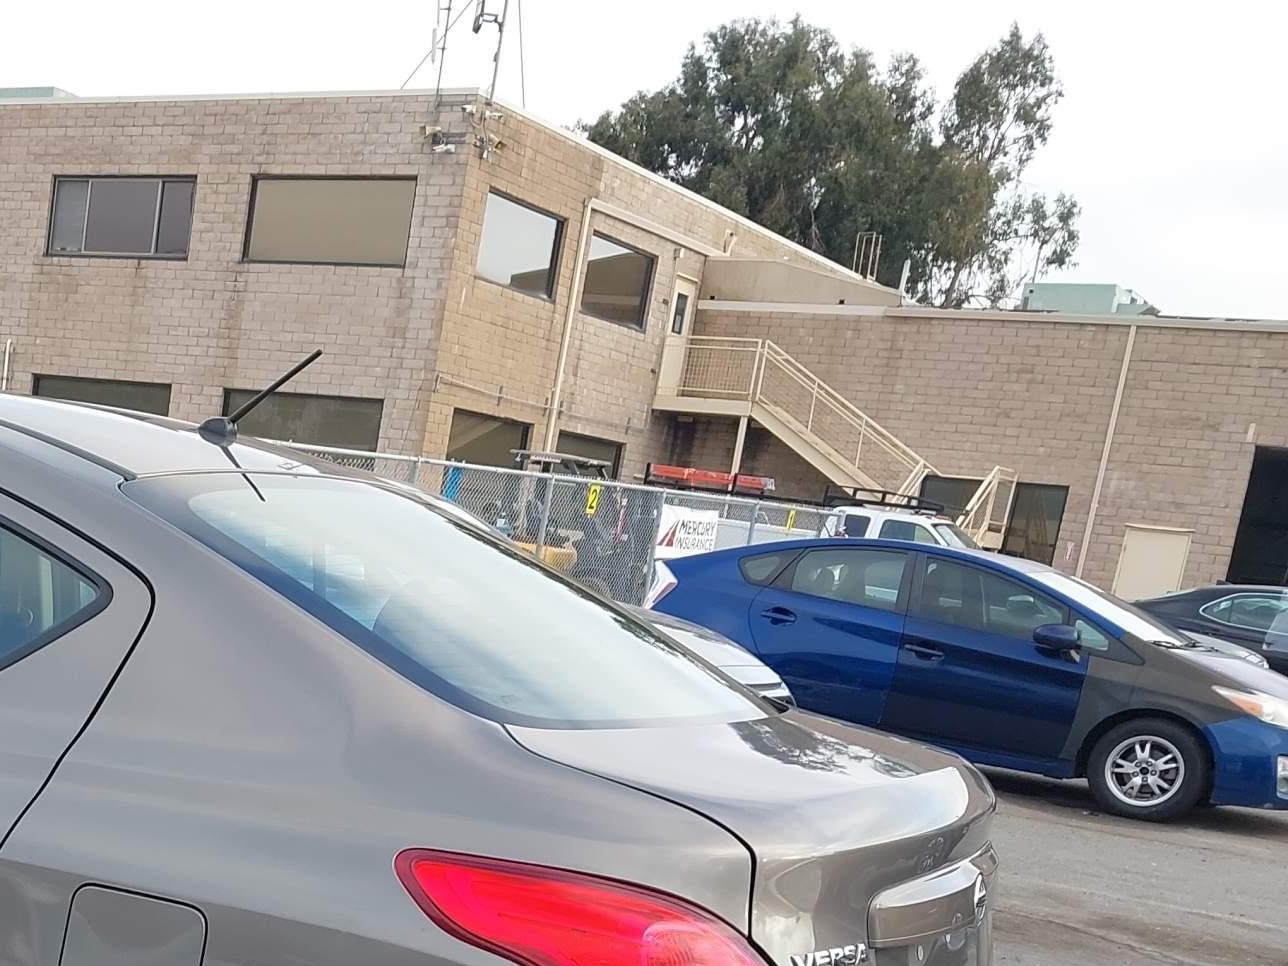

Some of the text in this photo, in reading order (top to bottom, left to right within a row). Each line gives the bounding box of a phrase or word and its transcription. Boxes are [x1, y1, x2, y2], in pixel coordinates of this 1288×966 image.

[588, 488, 598, 509] 2
[678, 519, 716, 536] MERCURY
[675, 536, 714, 551] INSURANCE
